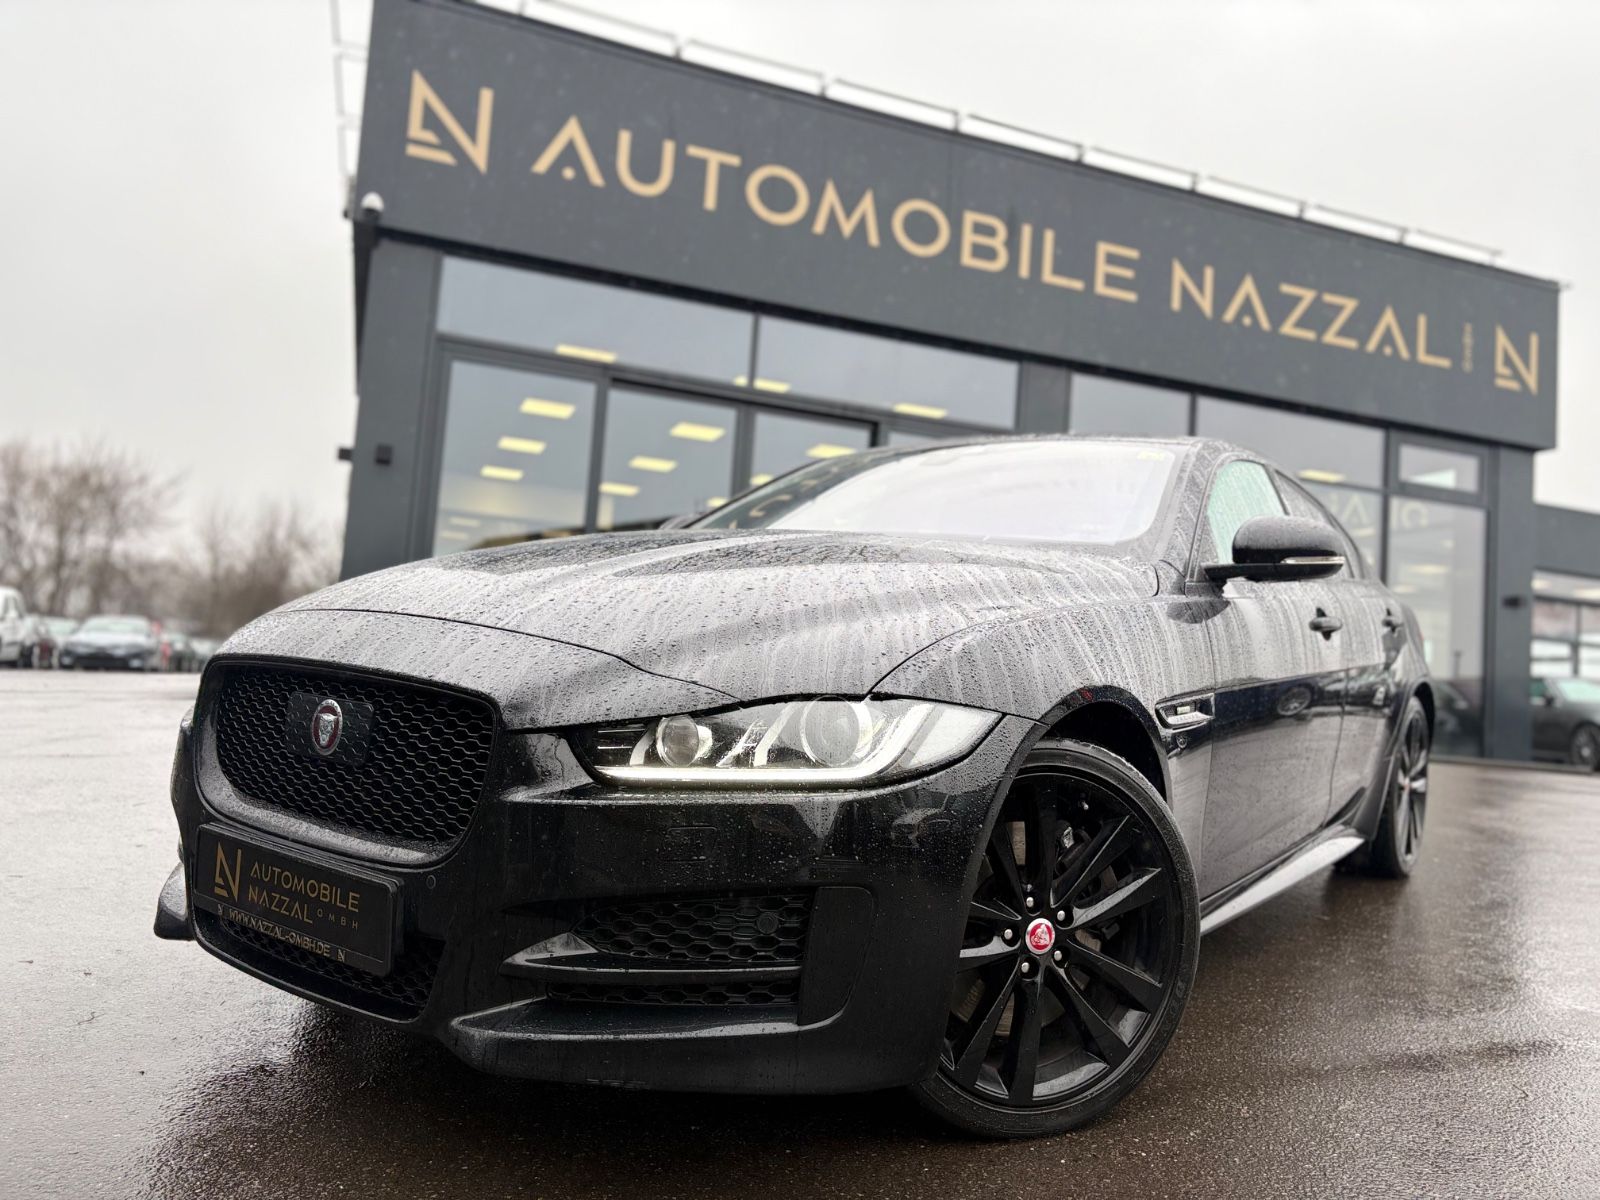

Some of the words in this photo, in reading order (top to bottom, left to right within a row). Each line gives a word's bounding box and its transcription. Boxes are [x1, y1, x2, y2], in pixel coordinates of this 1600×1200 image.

[531, 115, 1140, 303] AUTOMOBILE
[1171, 258, 1452, 368] NAZZAL
[249, 885, 313, 924] NAZZAL
[250, 861, 360, 912] AUTOMOBILE
